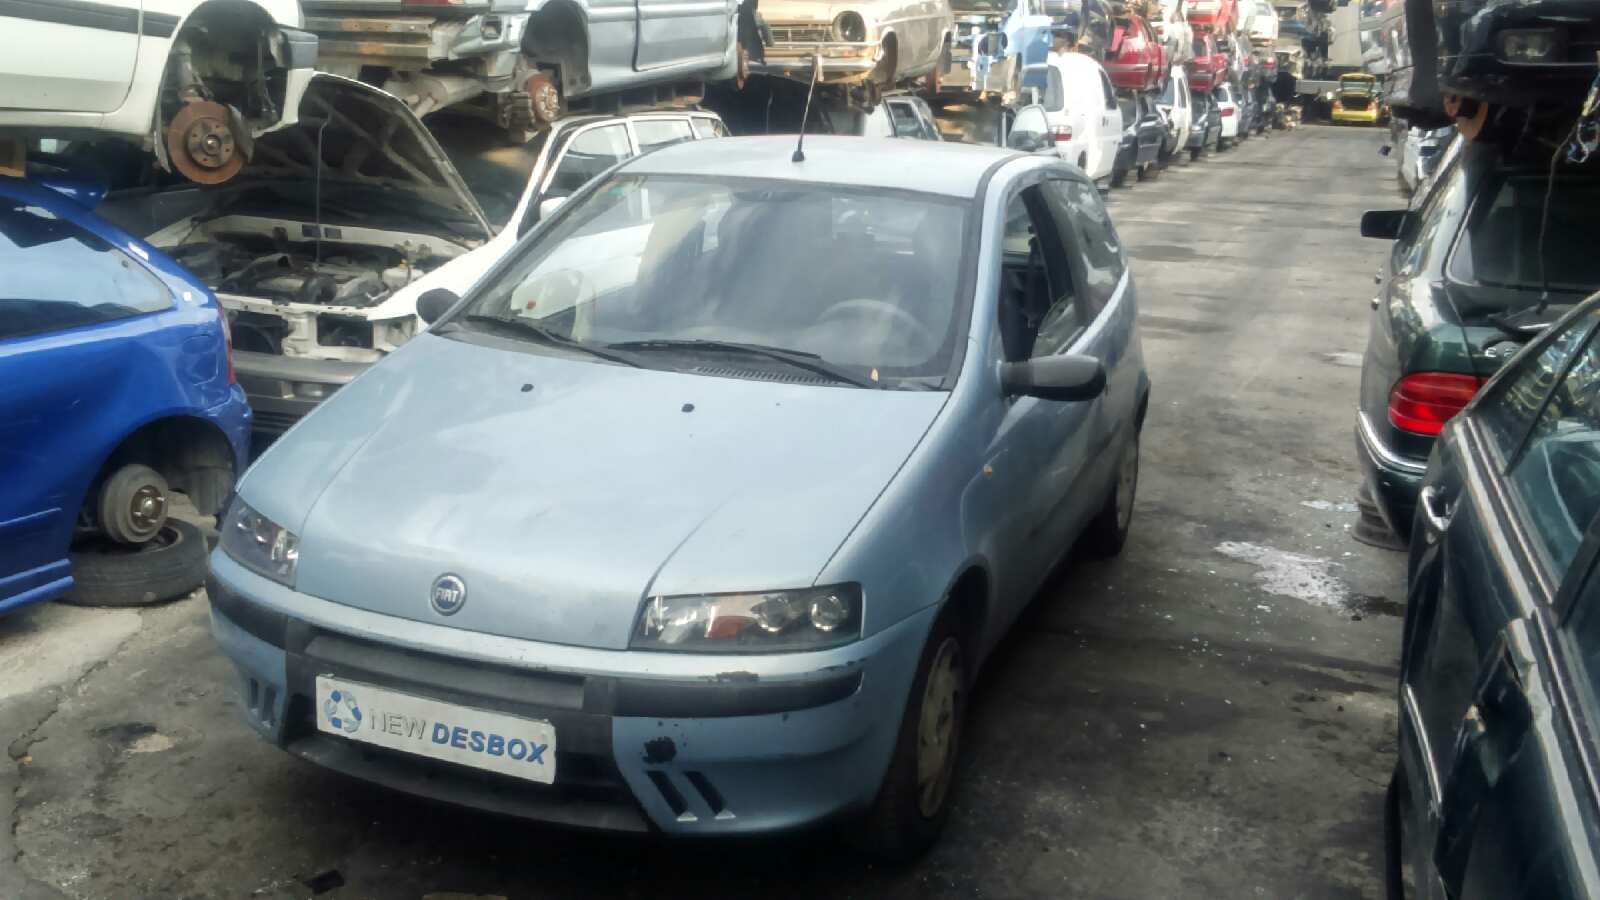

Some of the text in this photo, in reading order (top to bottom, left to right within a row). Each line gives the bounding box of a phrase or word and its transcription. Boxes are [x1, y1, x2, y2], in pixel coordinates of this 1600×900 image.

[436, 590, 459, 602] FIAT
[369, 709, 548, 764] NEW DESBOX
